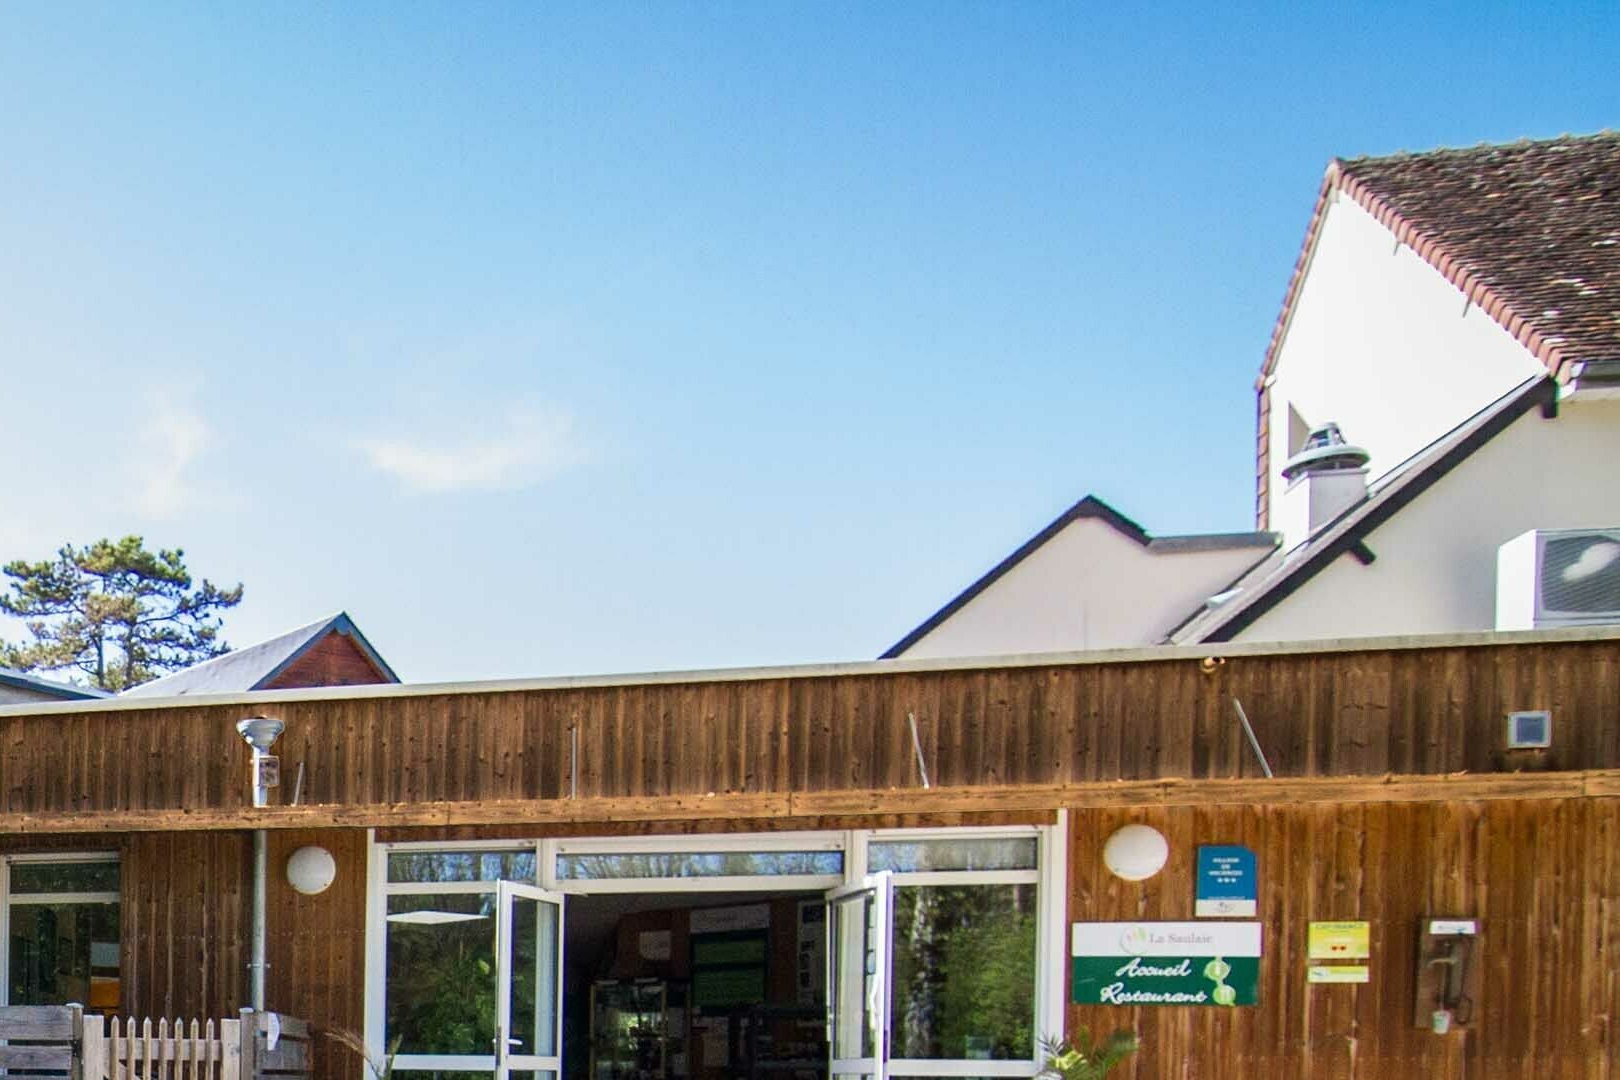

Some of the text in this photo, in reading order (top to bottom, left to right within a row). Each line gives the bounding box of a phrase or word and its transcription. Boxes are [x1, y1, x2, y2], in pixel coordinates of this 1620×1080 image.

[1149, 932, 1213, 945] La Saulaie
[1115, 957, 1192, 977] Accueil
[1100, 981, 1208, 1005] Restaurant
